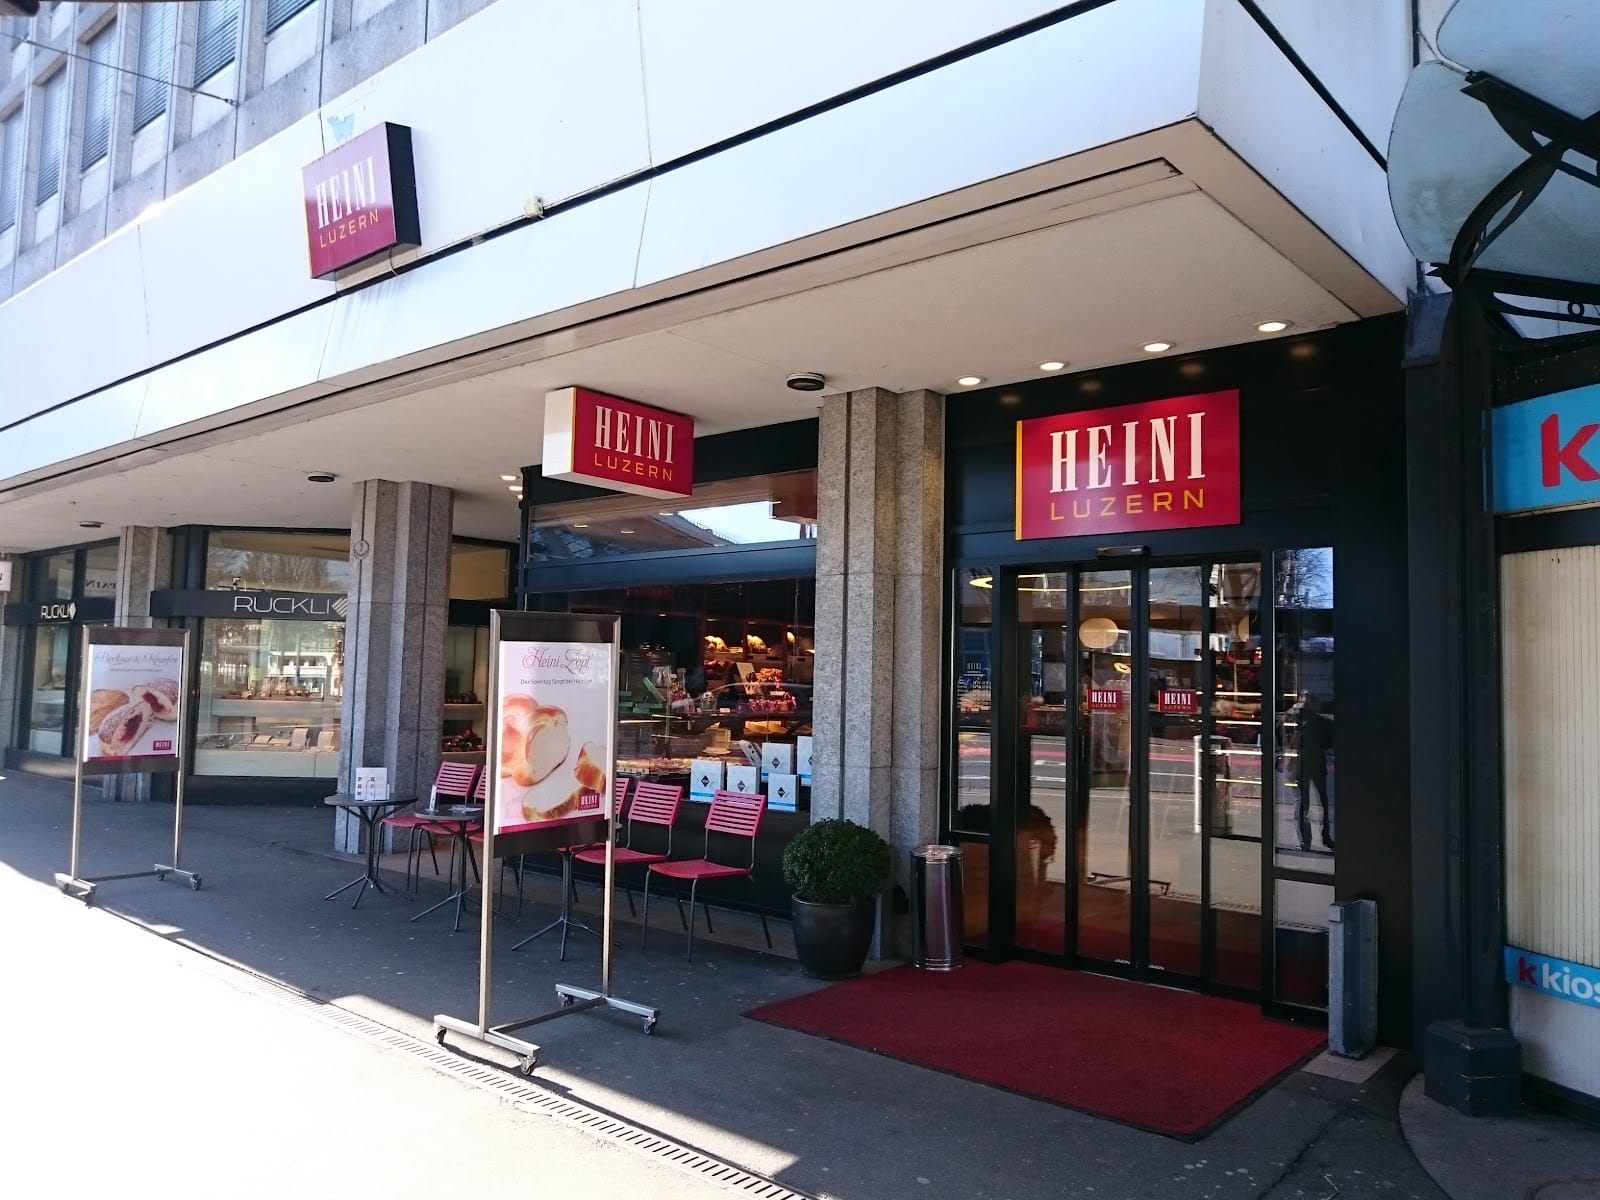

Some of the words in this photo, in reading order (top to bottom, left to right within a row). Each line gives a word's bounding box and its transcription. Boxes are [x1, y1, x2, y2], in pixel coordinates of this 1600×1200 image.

[315, 156, 376, 229] HEINI
[320, 208, 379, 248] LUZERN
[594, 405, 675, 464] HEINI
[594, 452, 672, 481] LUZERN
[1050, 412, 1206, 493] HEINI
[1051, 488, 1204, 521] LUZERN
[41, 604, 71, 619] RUCKLI
[234, 595, 330, 615] RUCKLI
[522, 647, 560, 669] Heini
[561, 648, 591, 675] Zopf
[1092, 691, 1117, 703] HEINI
[1164, 693, 1191, 705] HEINI
